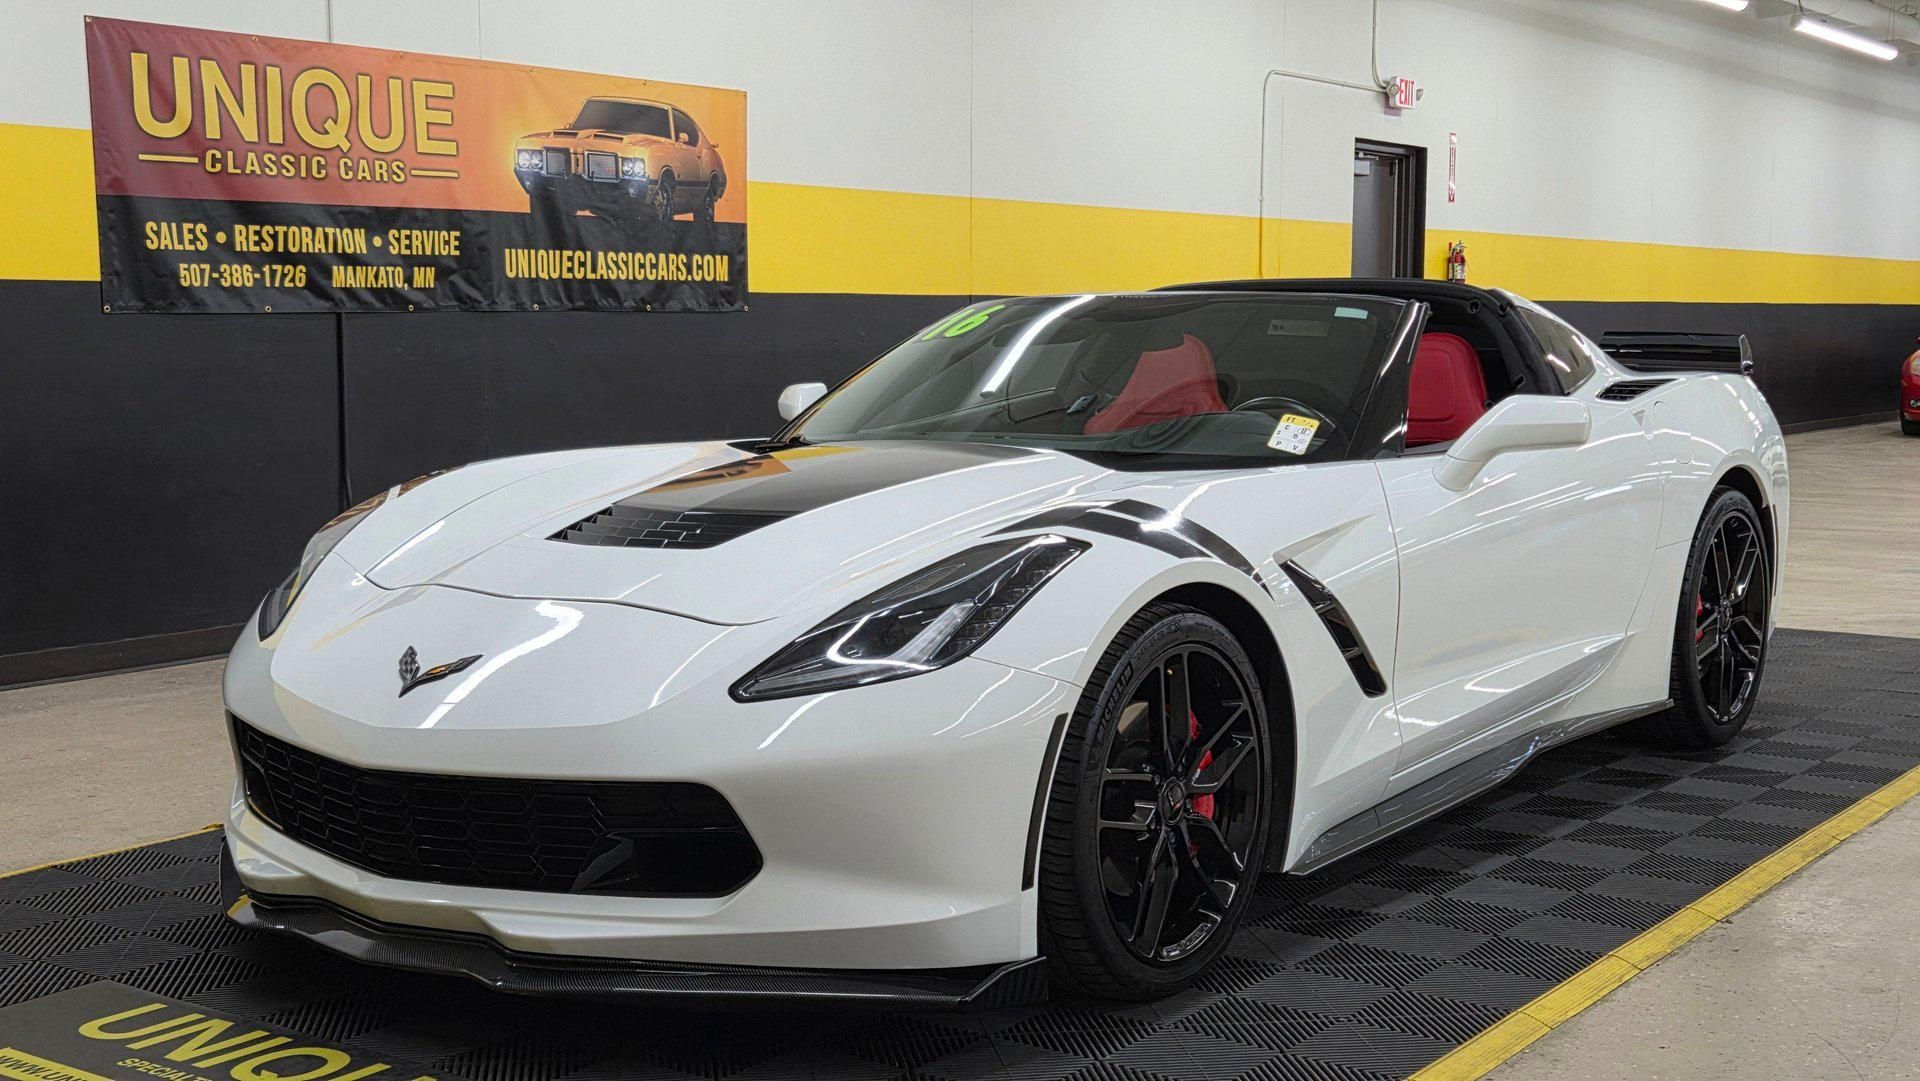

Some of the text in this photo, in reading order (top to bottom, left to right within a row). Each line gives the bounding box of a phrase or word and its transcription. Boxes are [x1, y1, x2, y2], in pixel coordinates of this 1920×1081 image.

[130, 53, 458, 156] UNIQUE
[1399, 79, 1415, 106] EXIT
[205, 149, 407, 183] CLASSIC CARS
[145, 221, 461, 256] SALES RESTORATION SERVICE
[179, 263, 435, 291] 507-386-1726 MANKATO, MN
[504, 248, 729, 282] UNIQUECLASSICCARS.COM
[79, 1003, 437, 1081] UNIQ
[117, 1058, 213, 1081] SPECIAL
